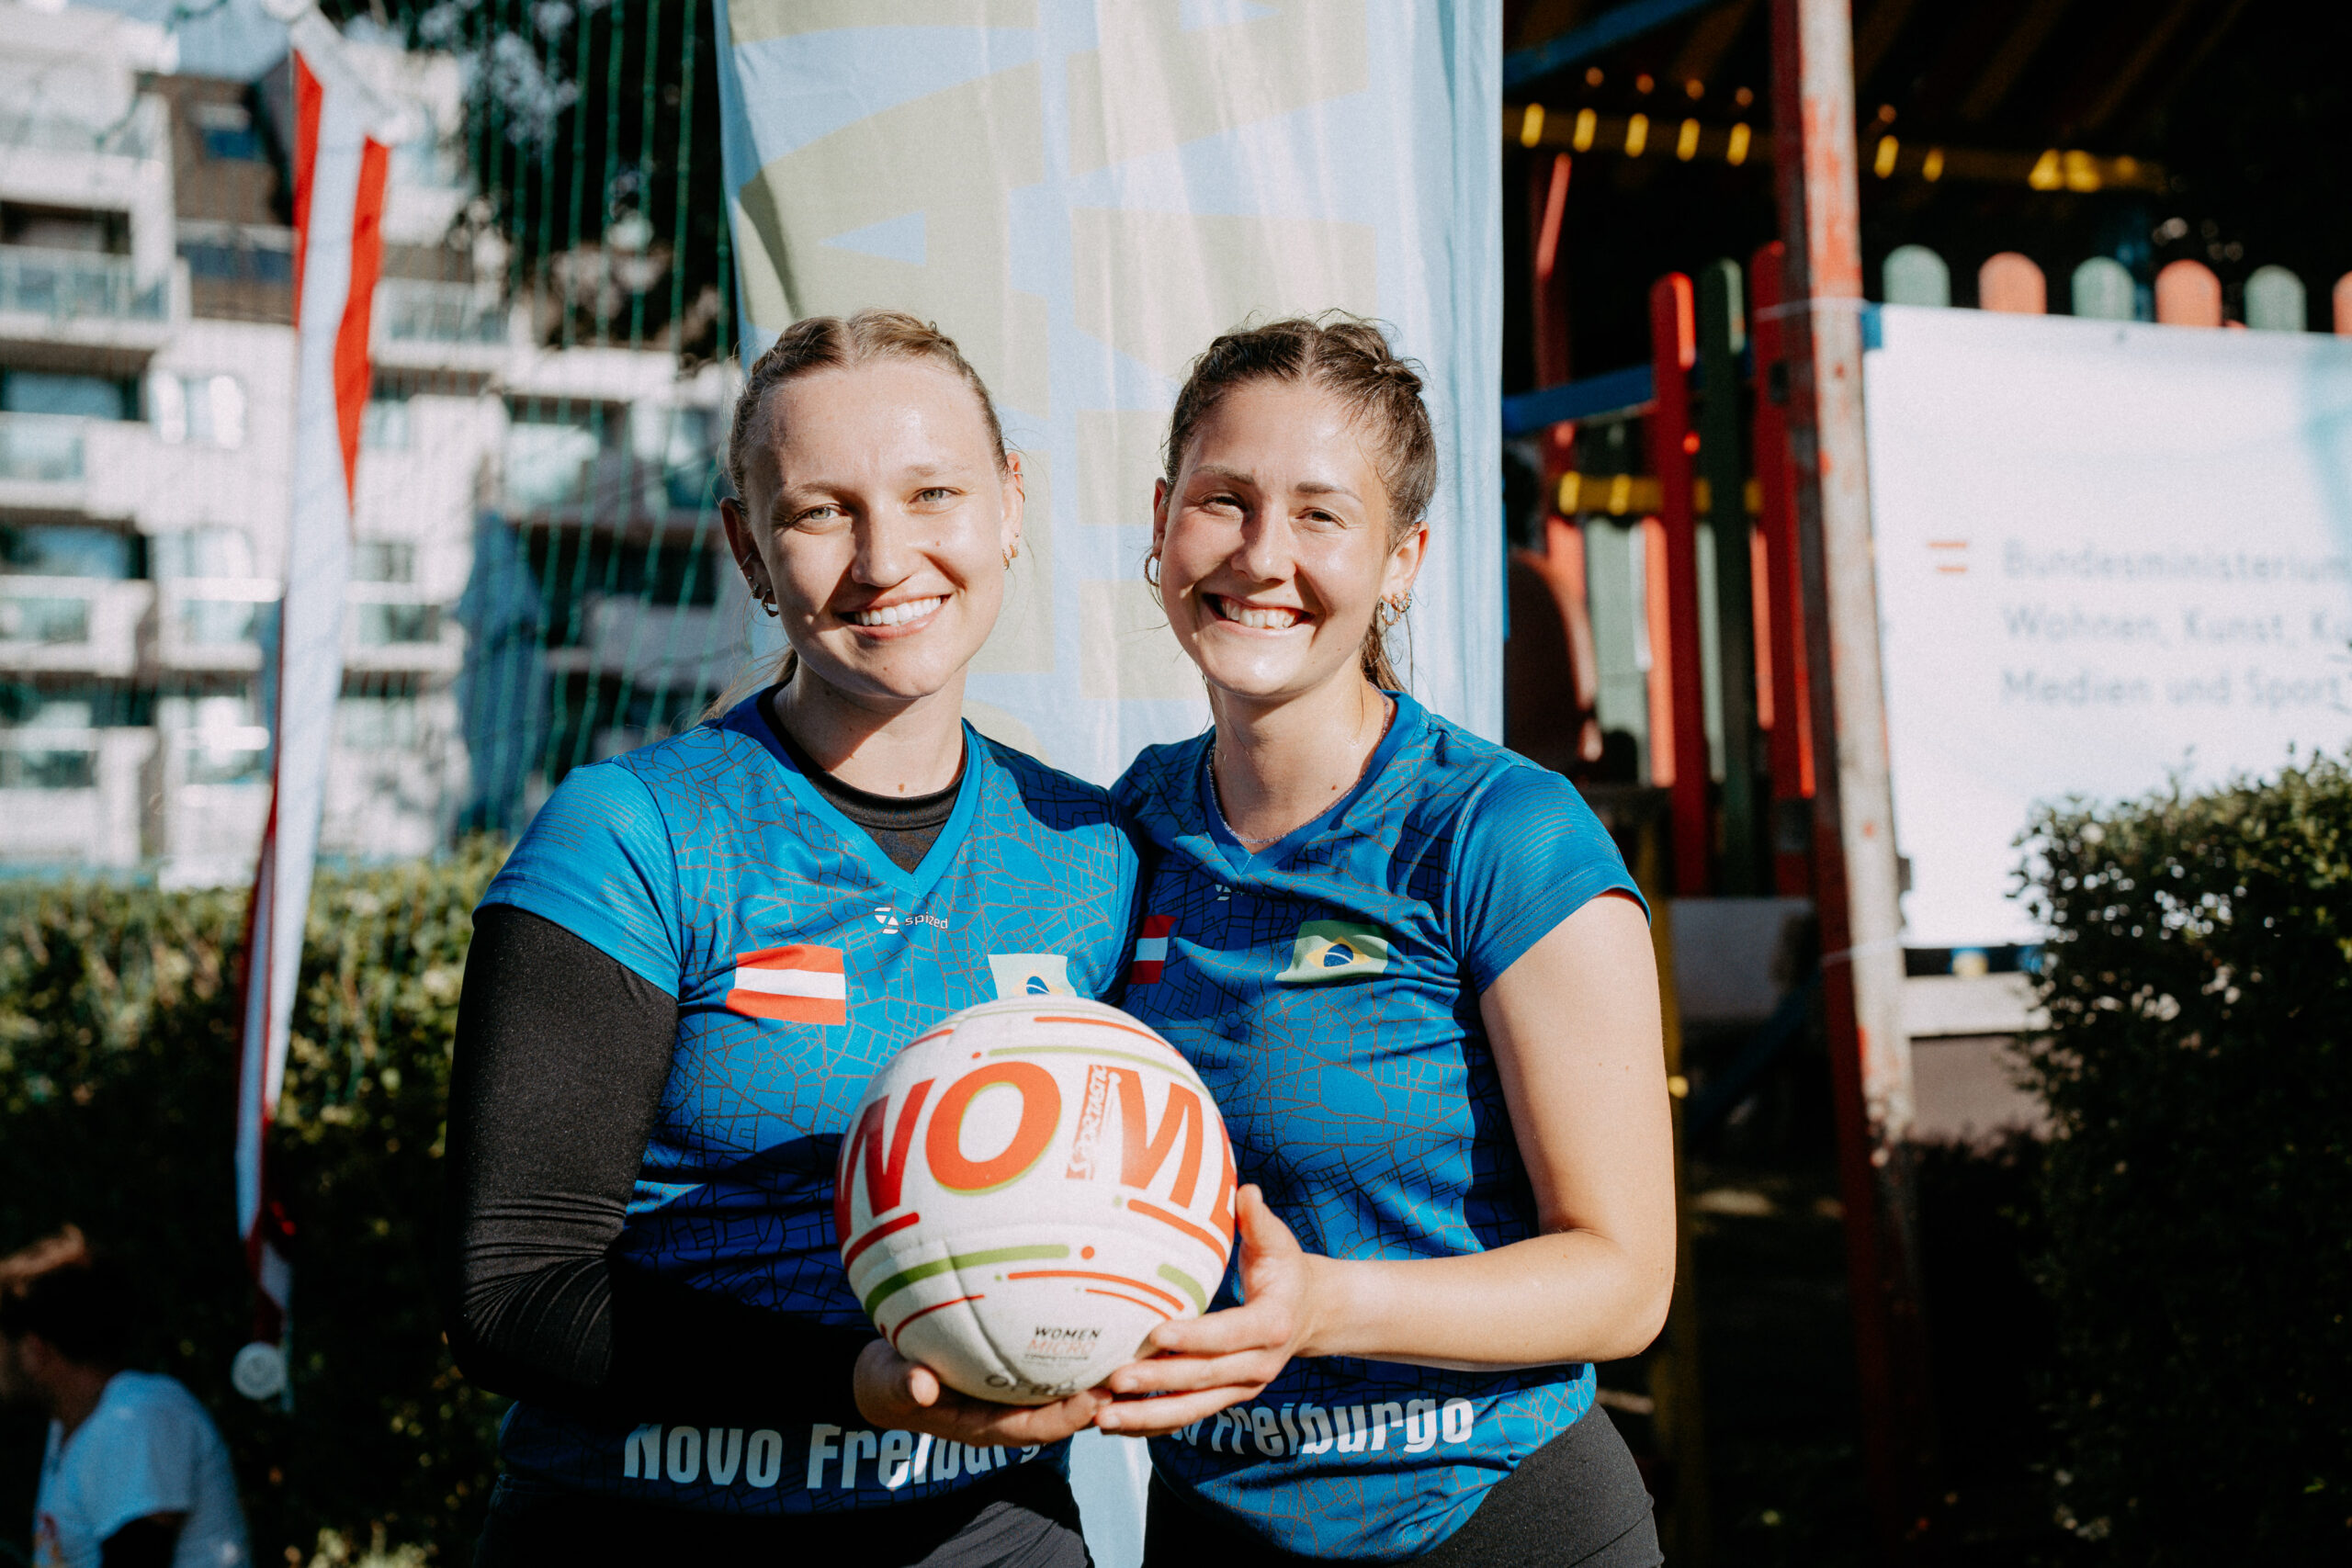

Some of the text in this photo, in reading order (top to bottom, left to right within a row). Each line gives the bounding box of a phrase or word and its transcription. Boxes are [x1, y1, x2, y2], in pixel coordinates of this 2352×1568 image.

[2002, 667, 2153, 705] Medien
[2165, 667, 2232, 705] und
[905, 911, 949, 930] spized
[1035, 1326, 1102, 1339] WOMEN
[623, 1423, 1046, 1491] Novo Freibur
